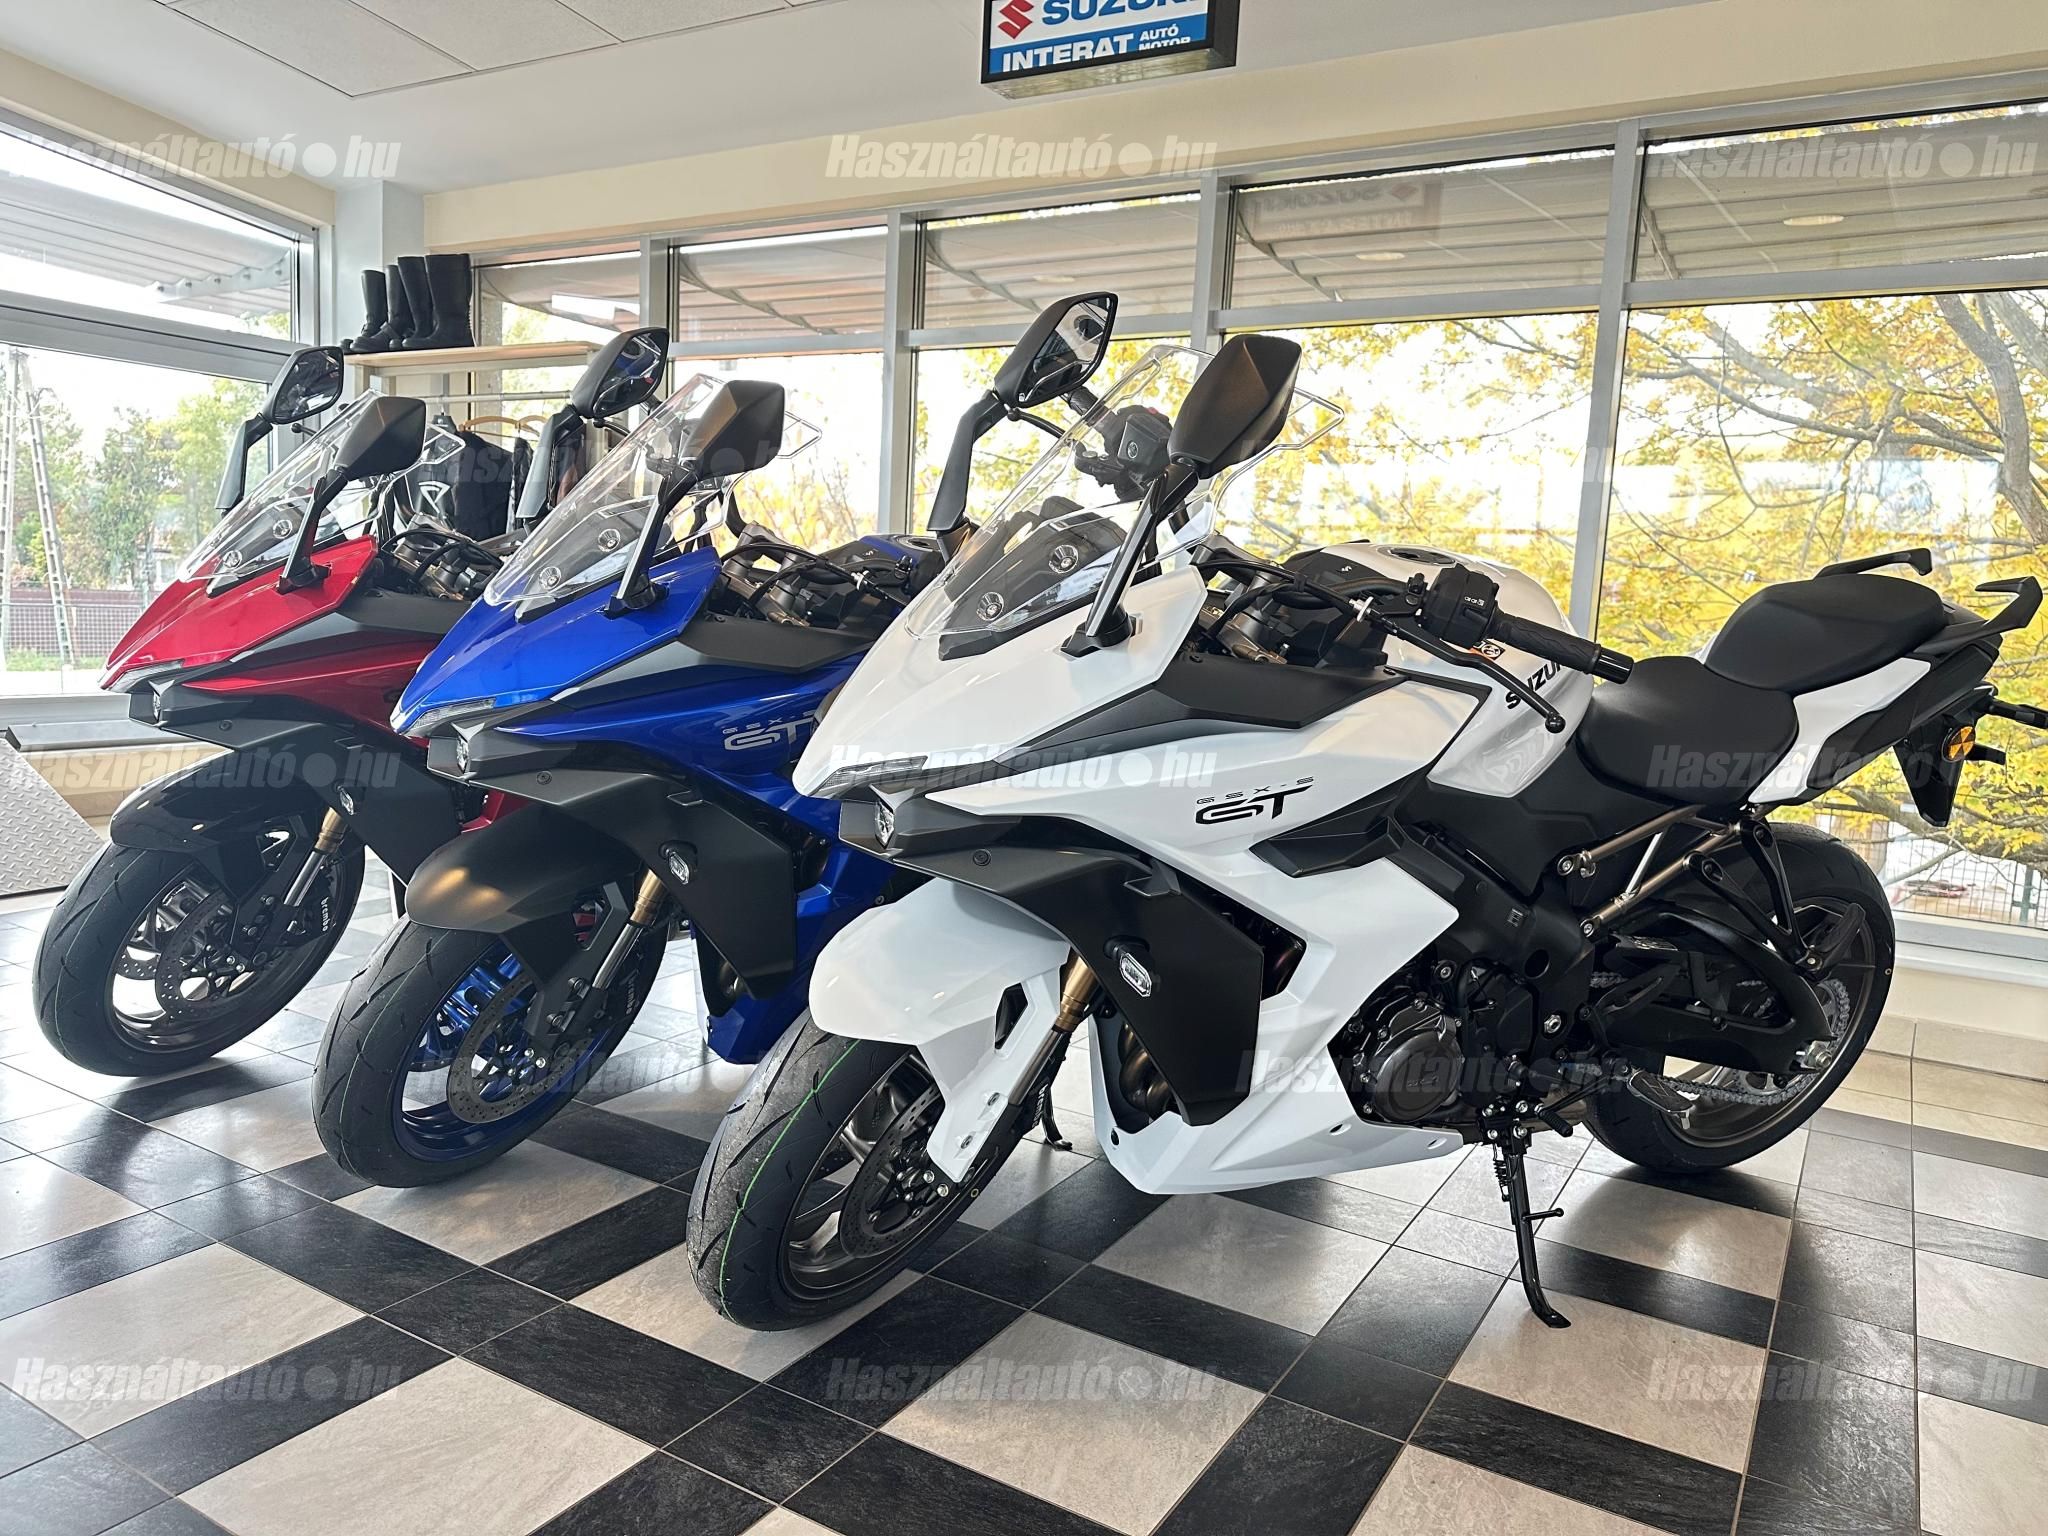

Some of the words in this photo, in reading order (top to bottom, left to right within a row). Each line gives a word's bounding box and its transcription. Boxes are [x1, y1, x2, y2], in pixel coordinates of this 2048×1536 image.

[1139, 23, 1179, 41] AUTÓ
[1002, 33, 1134, 73] INTERAT
[724, 717, 816, 751] GT
[1195, 784, 1313, 824] GT
[1196, 776, 1315, 805] GSX-S
[320, 896, 331, 932] brembo
